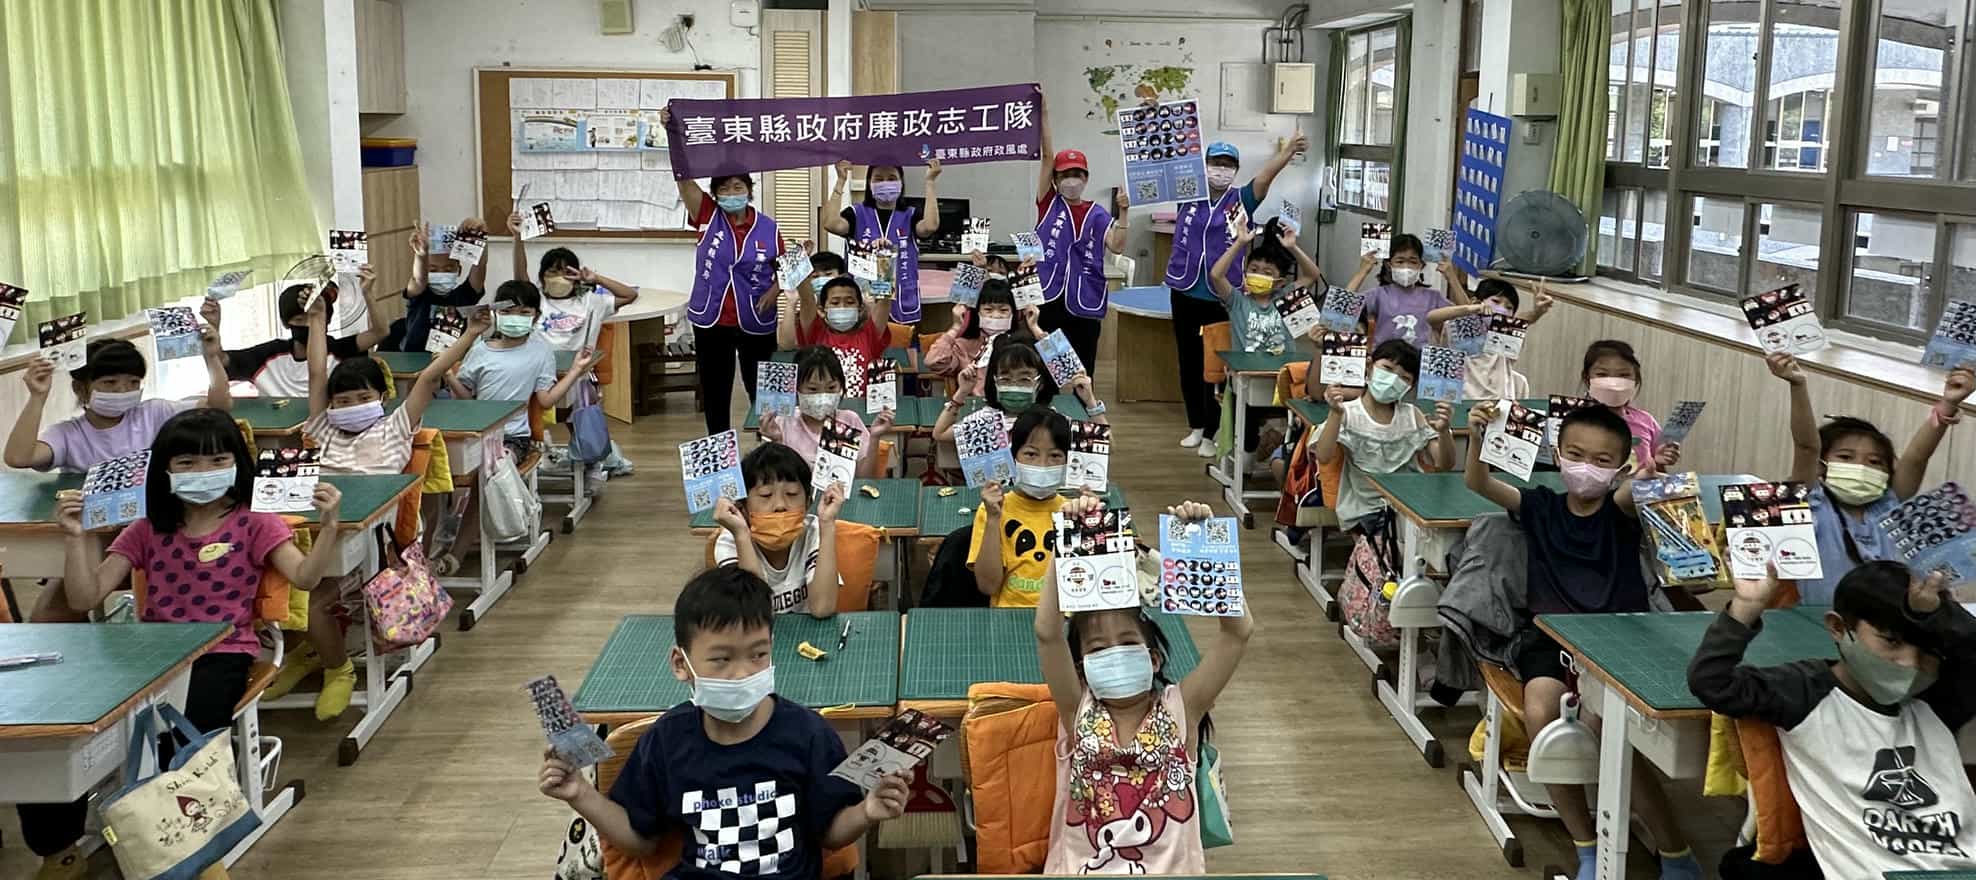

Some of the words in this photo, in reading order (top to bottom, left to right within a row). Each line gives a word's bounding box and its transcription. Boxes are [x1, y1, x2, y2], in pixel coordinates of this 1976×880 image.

[683, 101, 1034, 145] 臺東縣政府廉政志工隊
[936, 144, 1028, 159] 臺東縣政府政風處
[1863, 808, 1962, 838] DARTH
